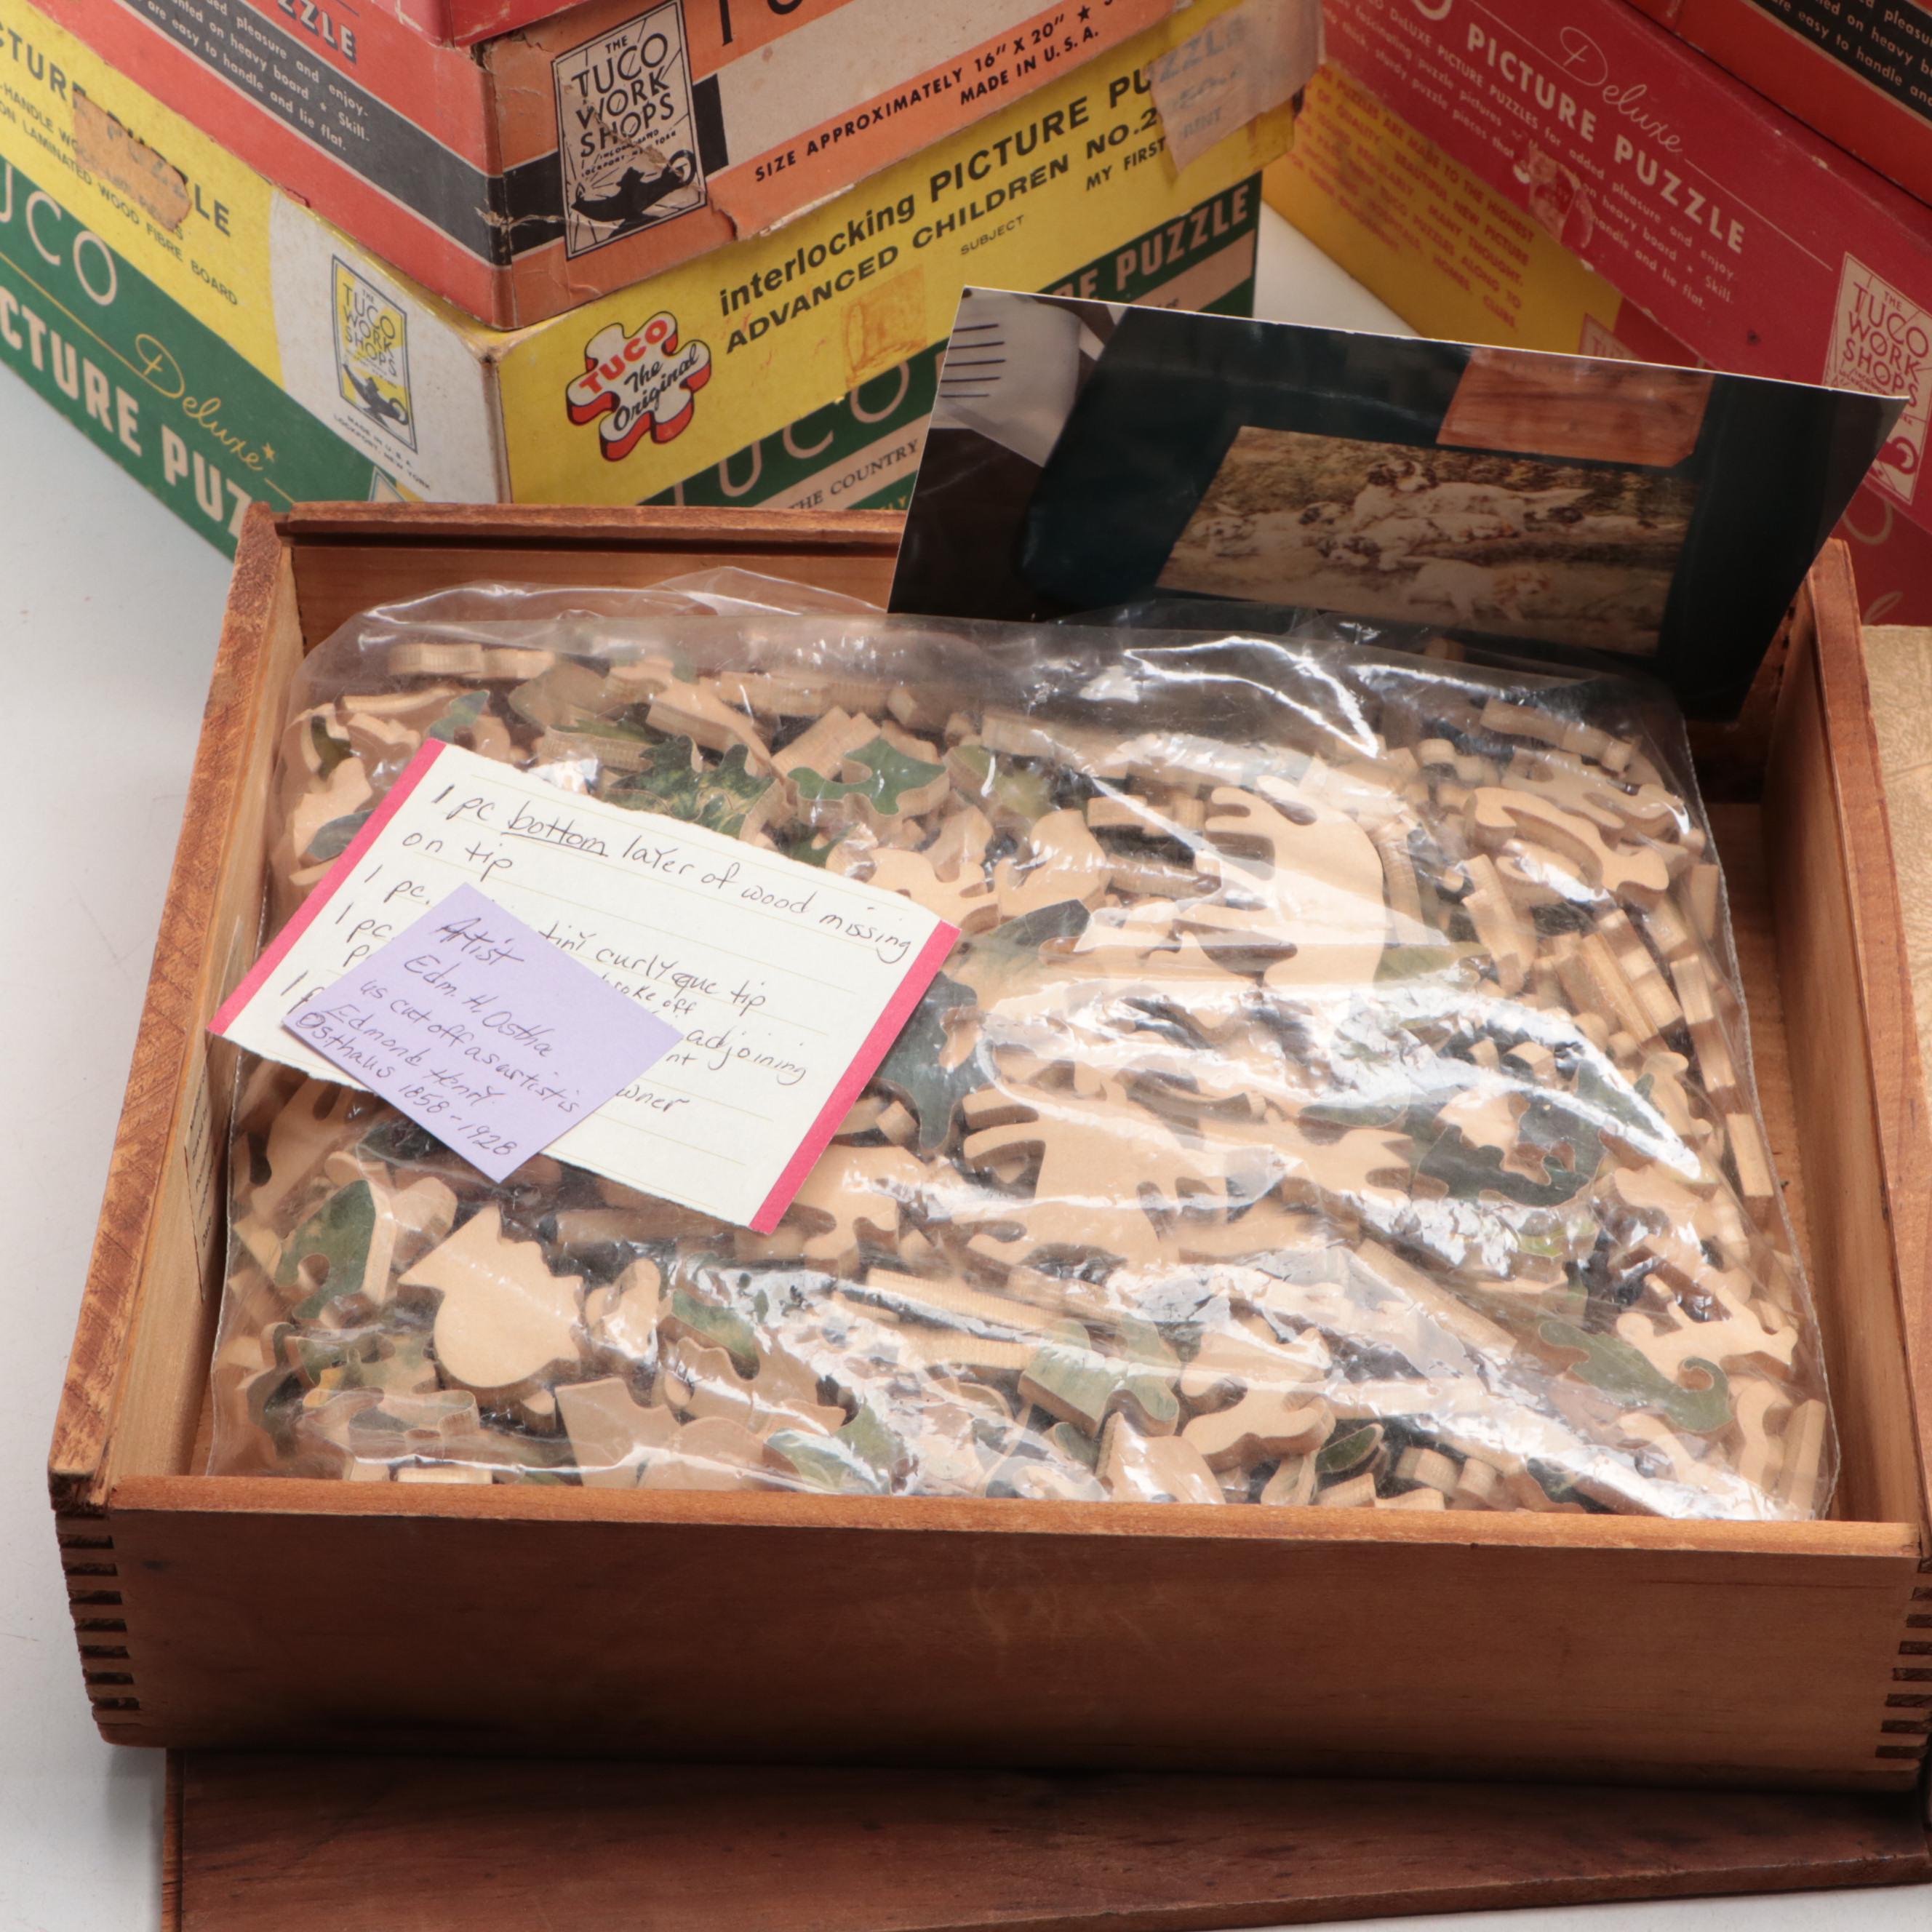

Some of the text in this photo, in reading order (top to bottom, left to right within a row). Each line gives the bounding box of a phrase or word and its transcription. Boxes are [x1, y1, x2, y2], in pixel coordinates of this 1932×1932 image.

[209, 21, 225, 39] on
[230, 33, 267, 72] heavy
[274, 65, 309, 100] board
[236, 15, 287, 60] pleasure
[296, 60, 320, 83] and
[570, 33, 668, 97] TUCO
[604, 35, 628, 54] THE
[1798, 11, 1829, 39] easy
[1835, 34, 1850, 51] to
[1856, 46, 1903, 87] handle
[1847, 15, 1914, 65] on heavy
[148, 1, 347, 151] are easy to handle and lie flat.
[575, 65, 670, 129] WORK
[959, 71, 1010, 106] MADE
[1016, 55, 1037, 76] IN
[1560, 26, 1683, 153] Deluxe
[580, 92, 674, 157] SHOPS
[754, 151, 797, 183] SIZE
[806, 66, 964, 156] APPROXIMATELY
[1437, 44, 1485, 88] PICTURE
[1490, 84, 1540, 130] PUZZLES
[1544, 126, 1562, 148] for
[1569, 149, 1605, 180] added
[1611, 181, 1661, 223] pleasure
[1669, 225, 1693, 248] and
[1466, 23, 1746, 255] PICTURE PUZZLE
[1085, 135, 1166, 191] MY FIRST
[1411, 77, 1449, 110] puzzle
[1452, 108, 1488, 140] pieces
[1635, 249, 1658, 272] and
[1662, 266, 1677, 288] lie
[1417, 57, 1455, 90] puzzle
[1459, 89, 1502, 127] pictures
[1602, 195, 1637, 232] heavy
[1642, 225, 1677, 261] board
[23, 120, 92, 185] LAMINATED
[98, 182, 140, 225] WOOD
[146, 222, 183, 263] FIBRE
[191, 259, 239, 306] BOARD
[719, 193, 915, 318] interlocking
[929, 96, 1090, 202] PICTURE
[959, 215, 1025, 256] SUBJECT
[1117, 185, 1250, 291] PUZZLE
[726, 244, 900, 355] ADVANCED
[911, 153, 1070, 250] CHILDREN
[342, 282, 396, 340] TUCO
[343, 305, 394, 359] WORK
[1852, 281, 1930, 359] TUCO
[1884, 290, 1903, 311] THE
[345, 324, 398, 378] SHOPS
[578, 319, 668, 395] TUCO
[623, 359, 663, 394] The
[1843, 337, 1919, 408] SHOPS
[1848, 310, 1921, 385] WORK
[135, 333, 263, 472] Deluxe
[612, 342, 700, 433] Original
[829, 439, 919, 495] COUNTRY
[402, 832, 514, 882] on tip
[445, 797, 497, 821] pc
[507, 800, 609, 857] bottom
[700, 861, 741, 890] of
[739, 890, 818, 915] wood
[819, 905, 911, 965] missing
[428, 917, 527, 967] Artist
[389, 996, 431, 1026] cut
[427, 1022, 475, 1048] off
[662, 997, 698, 1015] off
[730, 980, 767, 1017] tip
[295, 1012, 396, 1079] Osthaus
[322, 1004, 432, 1068] Edmond
[685, 1025, 807, 1086] adjoining
